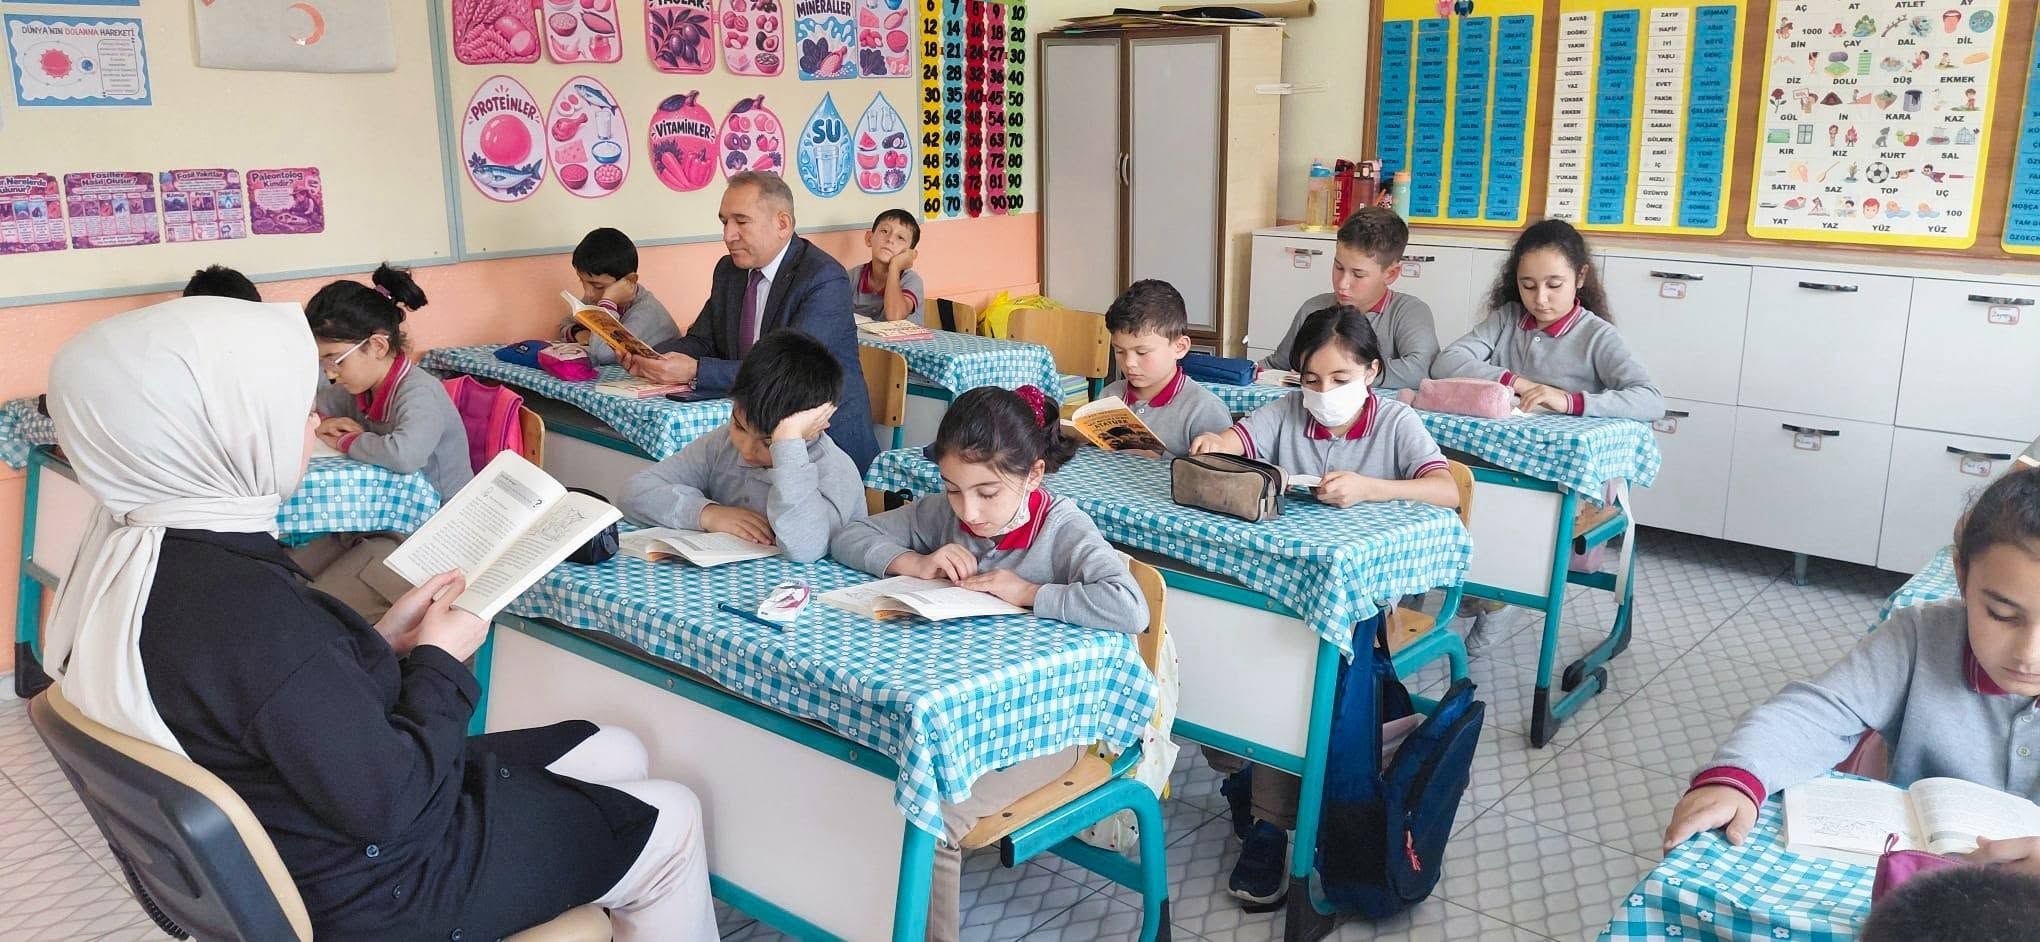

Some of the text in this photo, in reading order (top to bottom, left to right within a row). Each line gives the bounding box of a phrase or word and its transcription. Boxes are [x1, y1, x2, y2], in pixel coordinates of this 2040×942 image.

[796, 0, 851, 18] MİNERALLER
[926, 0, 934, 11] 6
[951, 0, 959, 15] 7
[992, 3, 1000, 18] 9
[1012, 5, 1025, 20] 10
[22, 25, 63, 36] DÜNYA'NIN
[100, 28, 135, 37] HAREKETİ
[924, 19, 937, 34] 12
[947, 20, 960, 36] 14
[991, 24, 1004, 40] 18
[1011, 27, 1025, 43] 20
[1957, 36, 1973, 44] DİL
[924, 41, 937, 57] 18
[947, 43, 961, 58] 21
[1843, 40, 1861, 48] ÇAY
[989, 47, 1004, 62] 27
[1009, 49, 1025, 64] 30
[923, 65, 938, 80] 24
[947, 65, 962, 81] 28
[969, 67, 983, 82] 32
[990, 69, 1004, 84] 36
[1008, 71, 1024, 86] 40
[1893, 76, 1912, 85] DÜŞ
[925, 87, 940, 103] 30
[947, 87, 962, 102] 35
[988, 91, 1004, 105] 45
[1009, 92, 1024, 107] 50
[471, 95, 537, 118] PROTEİNLER
[924, 110, 939, 125] 36
[946, 109, 962, 124] 42
[988, 112, 1004, 126] 54
[1008, 112, 1023, 127] 60
[656, 119, 712, 139] VİTAMİNLER
[811, 117, 842, 143] SU
[923, 132, 939, 147] 42
[945, 131, 960, 146] 49
[968, 132, 982, 147] 56
[990, 133, 1004, 147] 63
[1009, 134, 1023, 148] 70
[923, 154, 939, 169] 48
[945, 153, 959, 167] 56
[968, 154, 982, 168] 64
[991, 154, 1004, 168] 72
[1008, 154, 1022, 168] 80
[252, 171, 303, 182] Paleontolog
[924, 176, 940, 190] 54
[945, 174, 959, 189] 63
[968, 176, 981, 189] 72
[989, 174, 1004, 189] 81
[1008, 174, 1022, 188] 90
[924, 198, 940, 213] 60
[945, 196, 960, 211] 70
[991, 195, 1007, 210] 90
[1007, 194, 1023, 209] 100
[1928, 225, 1947, 233] YÜZ
[532, 498, 543, 509] ?
